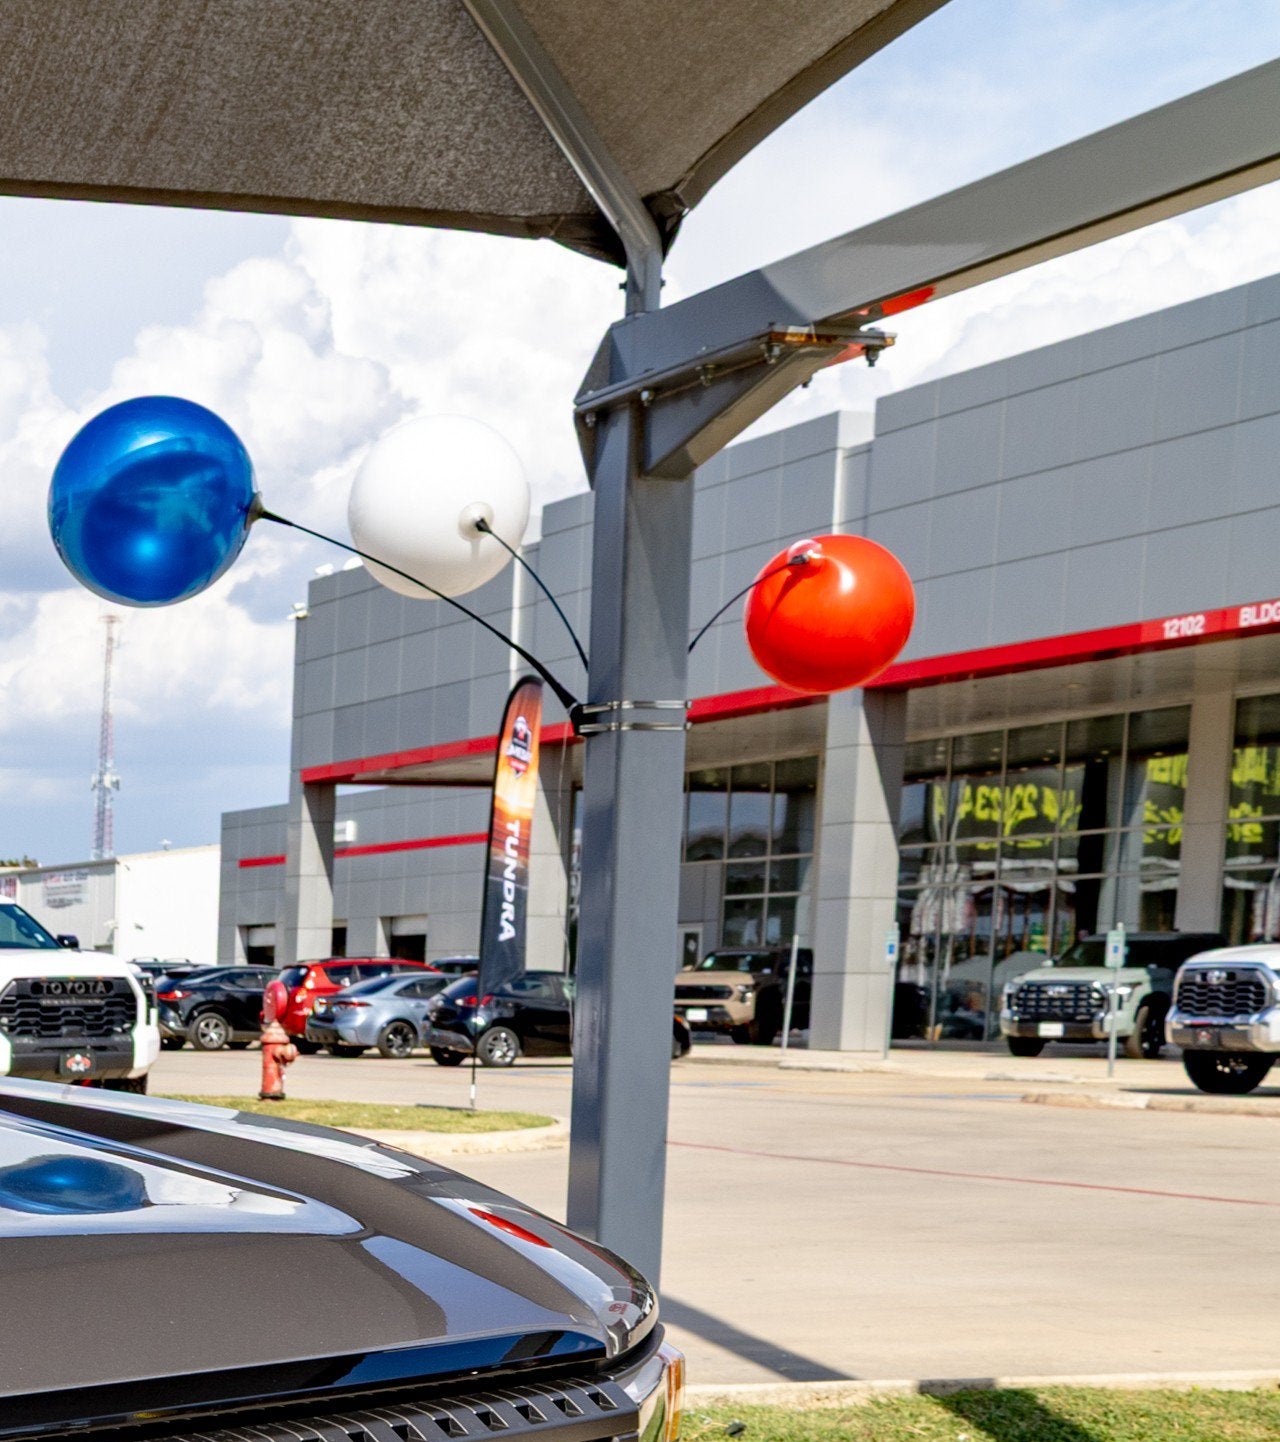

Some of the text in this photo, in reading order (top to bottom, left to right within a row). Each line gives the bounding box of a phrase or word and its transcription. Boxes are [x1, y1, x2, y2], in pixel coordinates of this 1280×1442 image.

[1163, 614, 1205, 640] 12102
[498, 819, 520, 942] TUNDRA
[40, 981, 107, 994] TOYOTA
